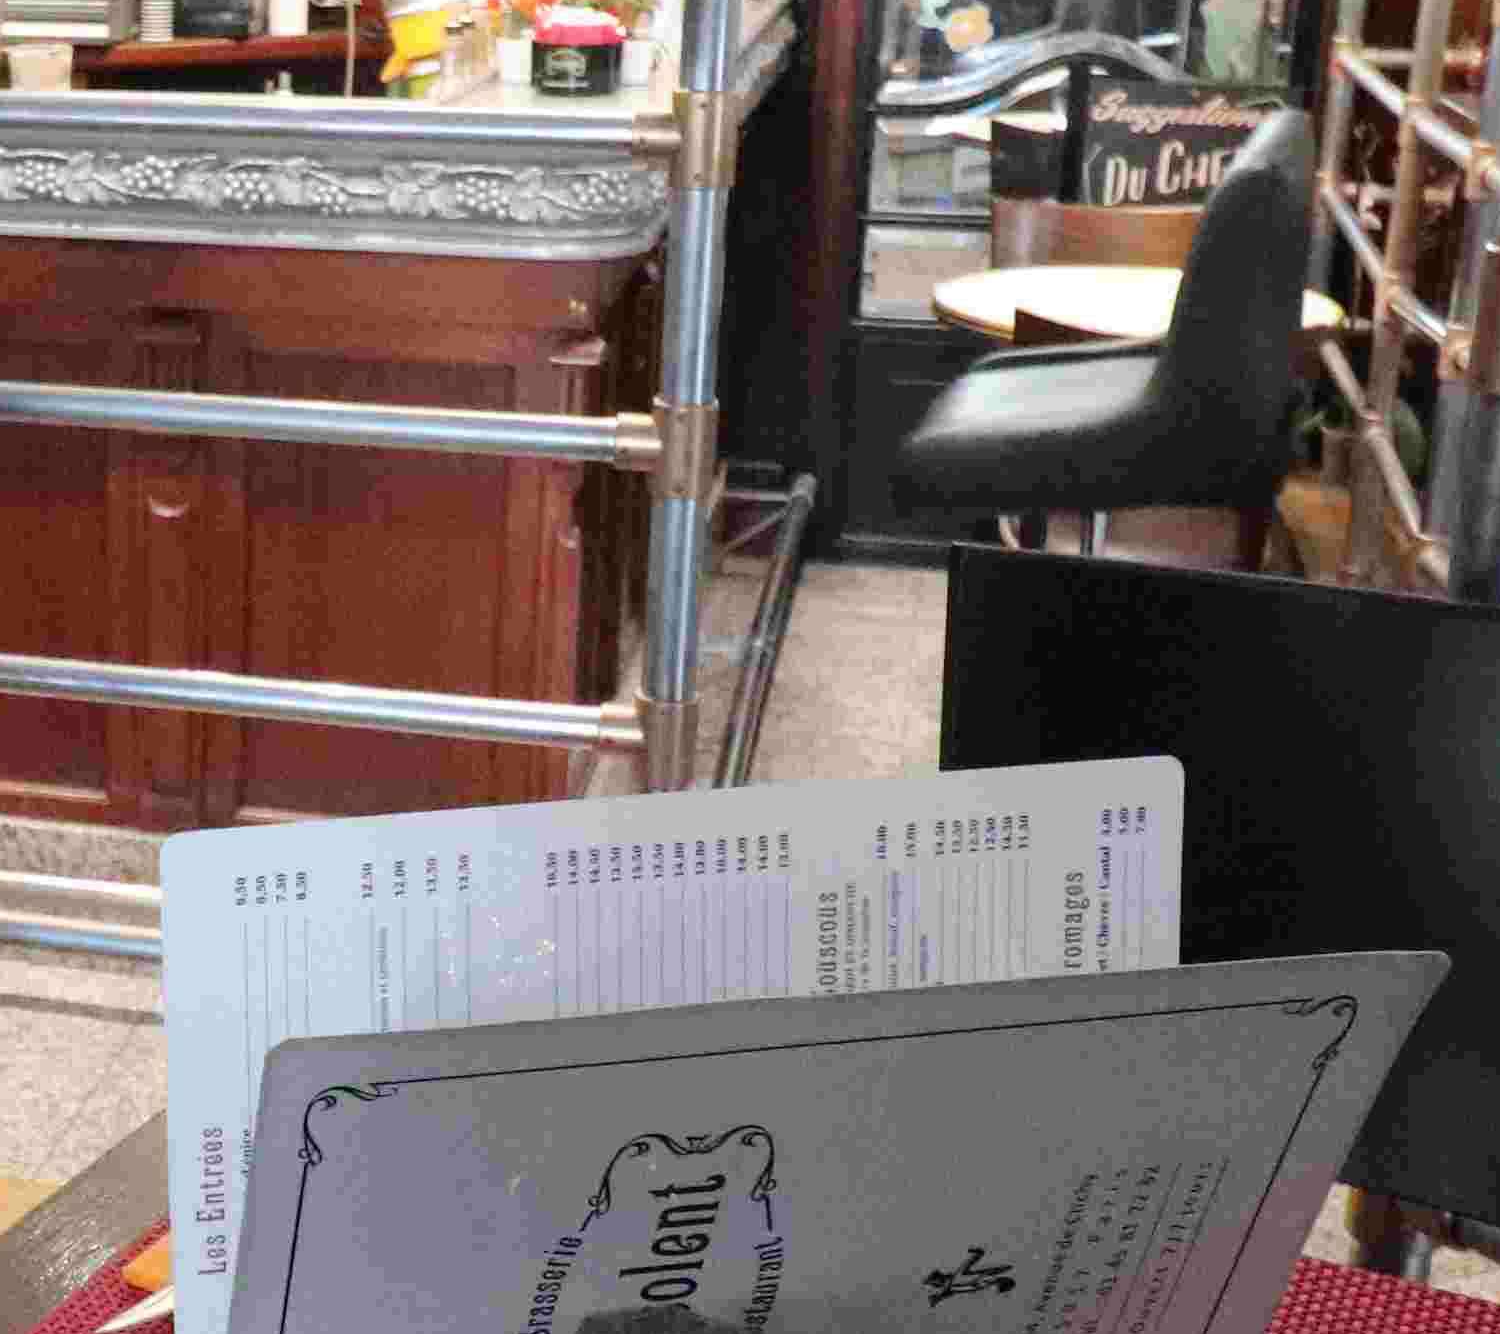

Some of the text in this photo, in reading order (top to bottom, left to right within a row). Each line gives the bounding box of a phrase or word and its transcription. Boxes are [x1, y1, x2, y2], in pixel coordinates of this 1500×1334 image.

[816, 891, 838, 993] ouscous
[1064, 871, 1090, 968] romages
[195, 1127, 227, 1275] Les Entrées
[617, 1173, 727, 1311] olent
[744, 1235, 784, 1327] staurant
